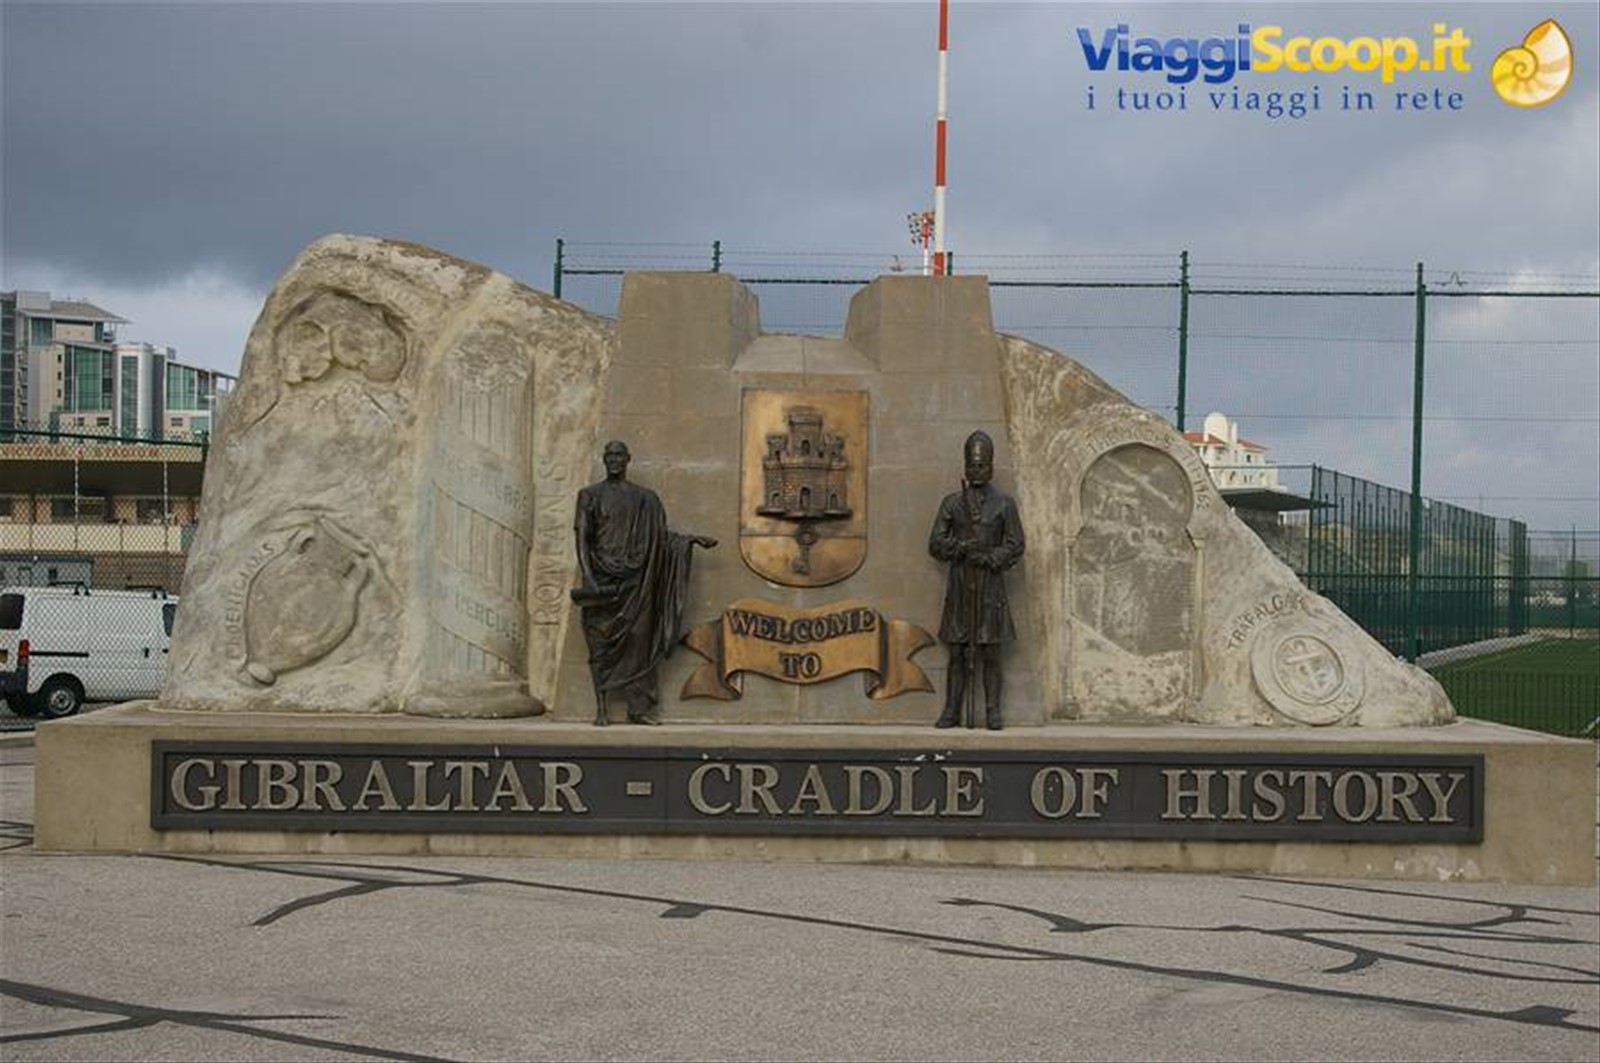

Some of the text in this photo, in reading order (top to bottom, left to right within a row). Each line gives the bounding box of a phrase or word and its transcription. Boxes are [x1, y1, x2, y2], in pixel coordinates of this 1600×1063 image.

[533, 459, 571, 627] ROMANS
[725, 607, 876, 643] WELCOME
[780, 652, 821, 678] TO
[171, 758, 588, 815] GIBRALTAR
[688, 763, 985, 819] CRADLE
[1030, 766, 1120, 820] OF
[1161, 768, 1466, 824] HISTORY
